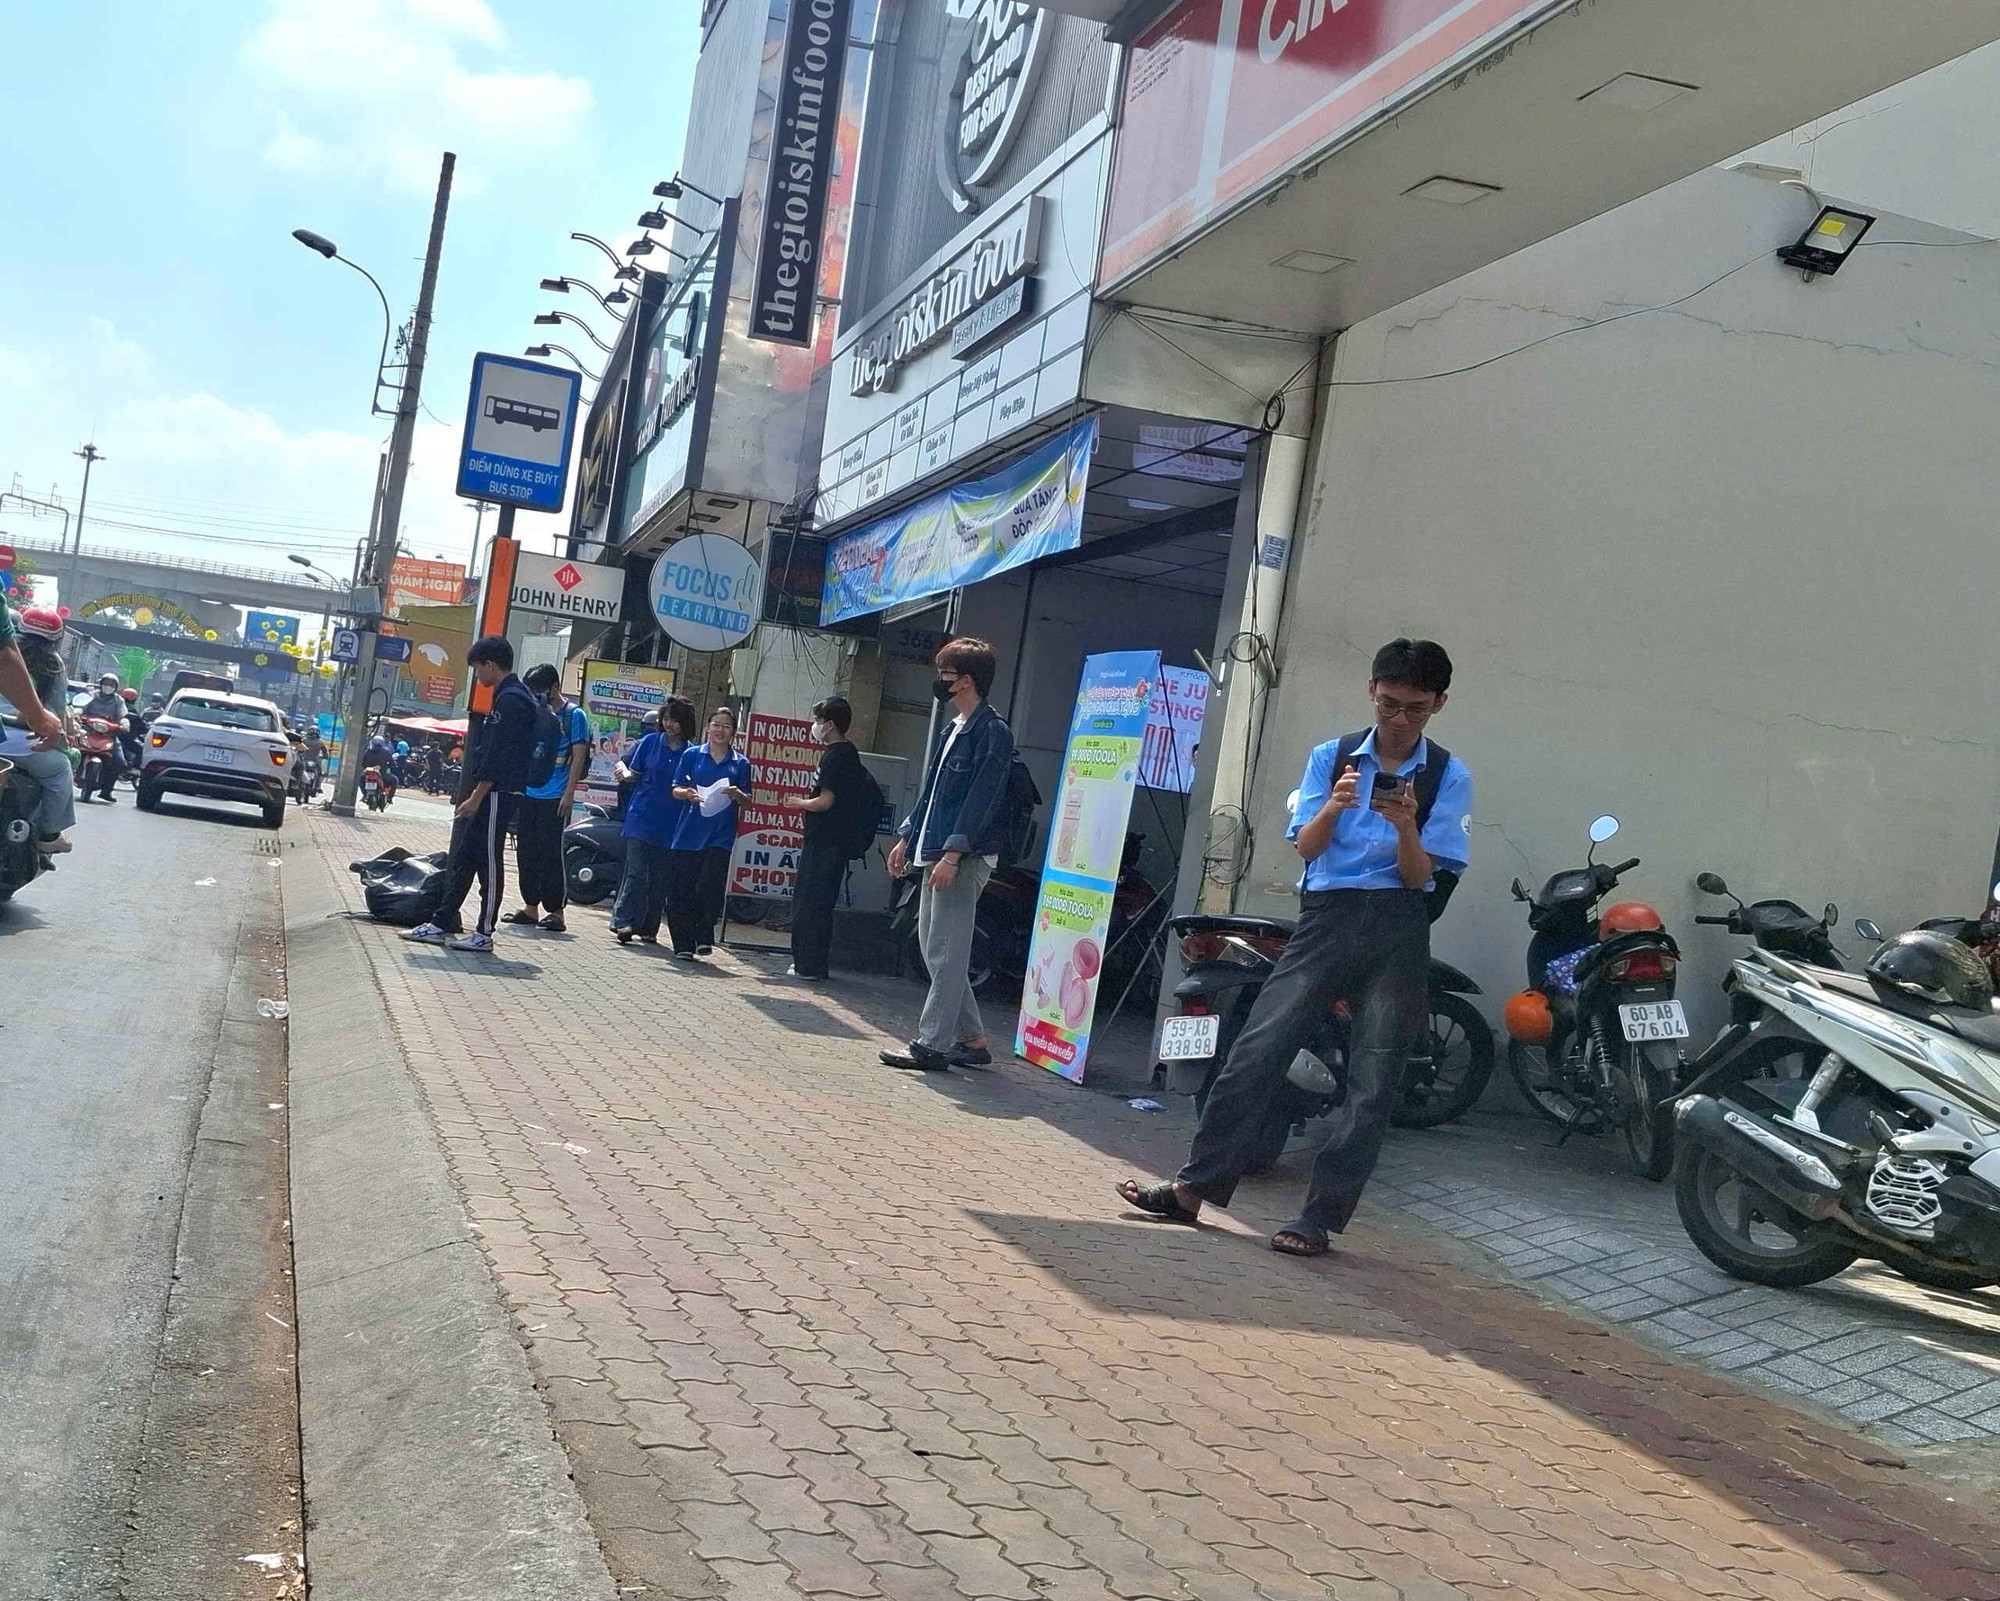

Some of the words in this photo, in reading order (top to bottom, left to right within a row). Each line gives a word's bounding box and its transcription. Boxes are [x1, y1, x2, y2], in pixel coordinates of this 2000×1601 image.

[469, 456, 492, 474] ĐIỂM
[521, 468, 535, 483] XE
[534, 470, 560, 488] BUÝT
[489, 480, 508, 495] BUS
[509, 484, 533, 500] STOP
[425, 578, 461, 593] NGAY
[662, 561, 732, 602] FOCUS
[510, 586, 556, 608] JOHN
[559, 594, 619, 619] HENRY
[658, 597, 750, 632] LEARNING
[593, 686, 612, 697] THE
[753, 721, 767, 736] IN
[768, 719, 807, 744] QUẢNG
[750, 741, 764, 759] IN
[765, 743, 825, 768] BACKDRO
[751, 764, 764, 783] IN
[743, 807, 764, 825] BÌA
[744, 850, 770, 866] IN
[1629, 1005, 1674, 1022] 60-AB
[1170, 1018, 1210, 1038] 59-XB
[1627, 1020, 1684, 1039] 676.04
[1164, 1037, 1211, 1057] 338.98
